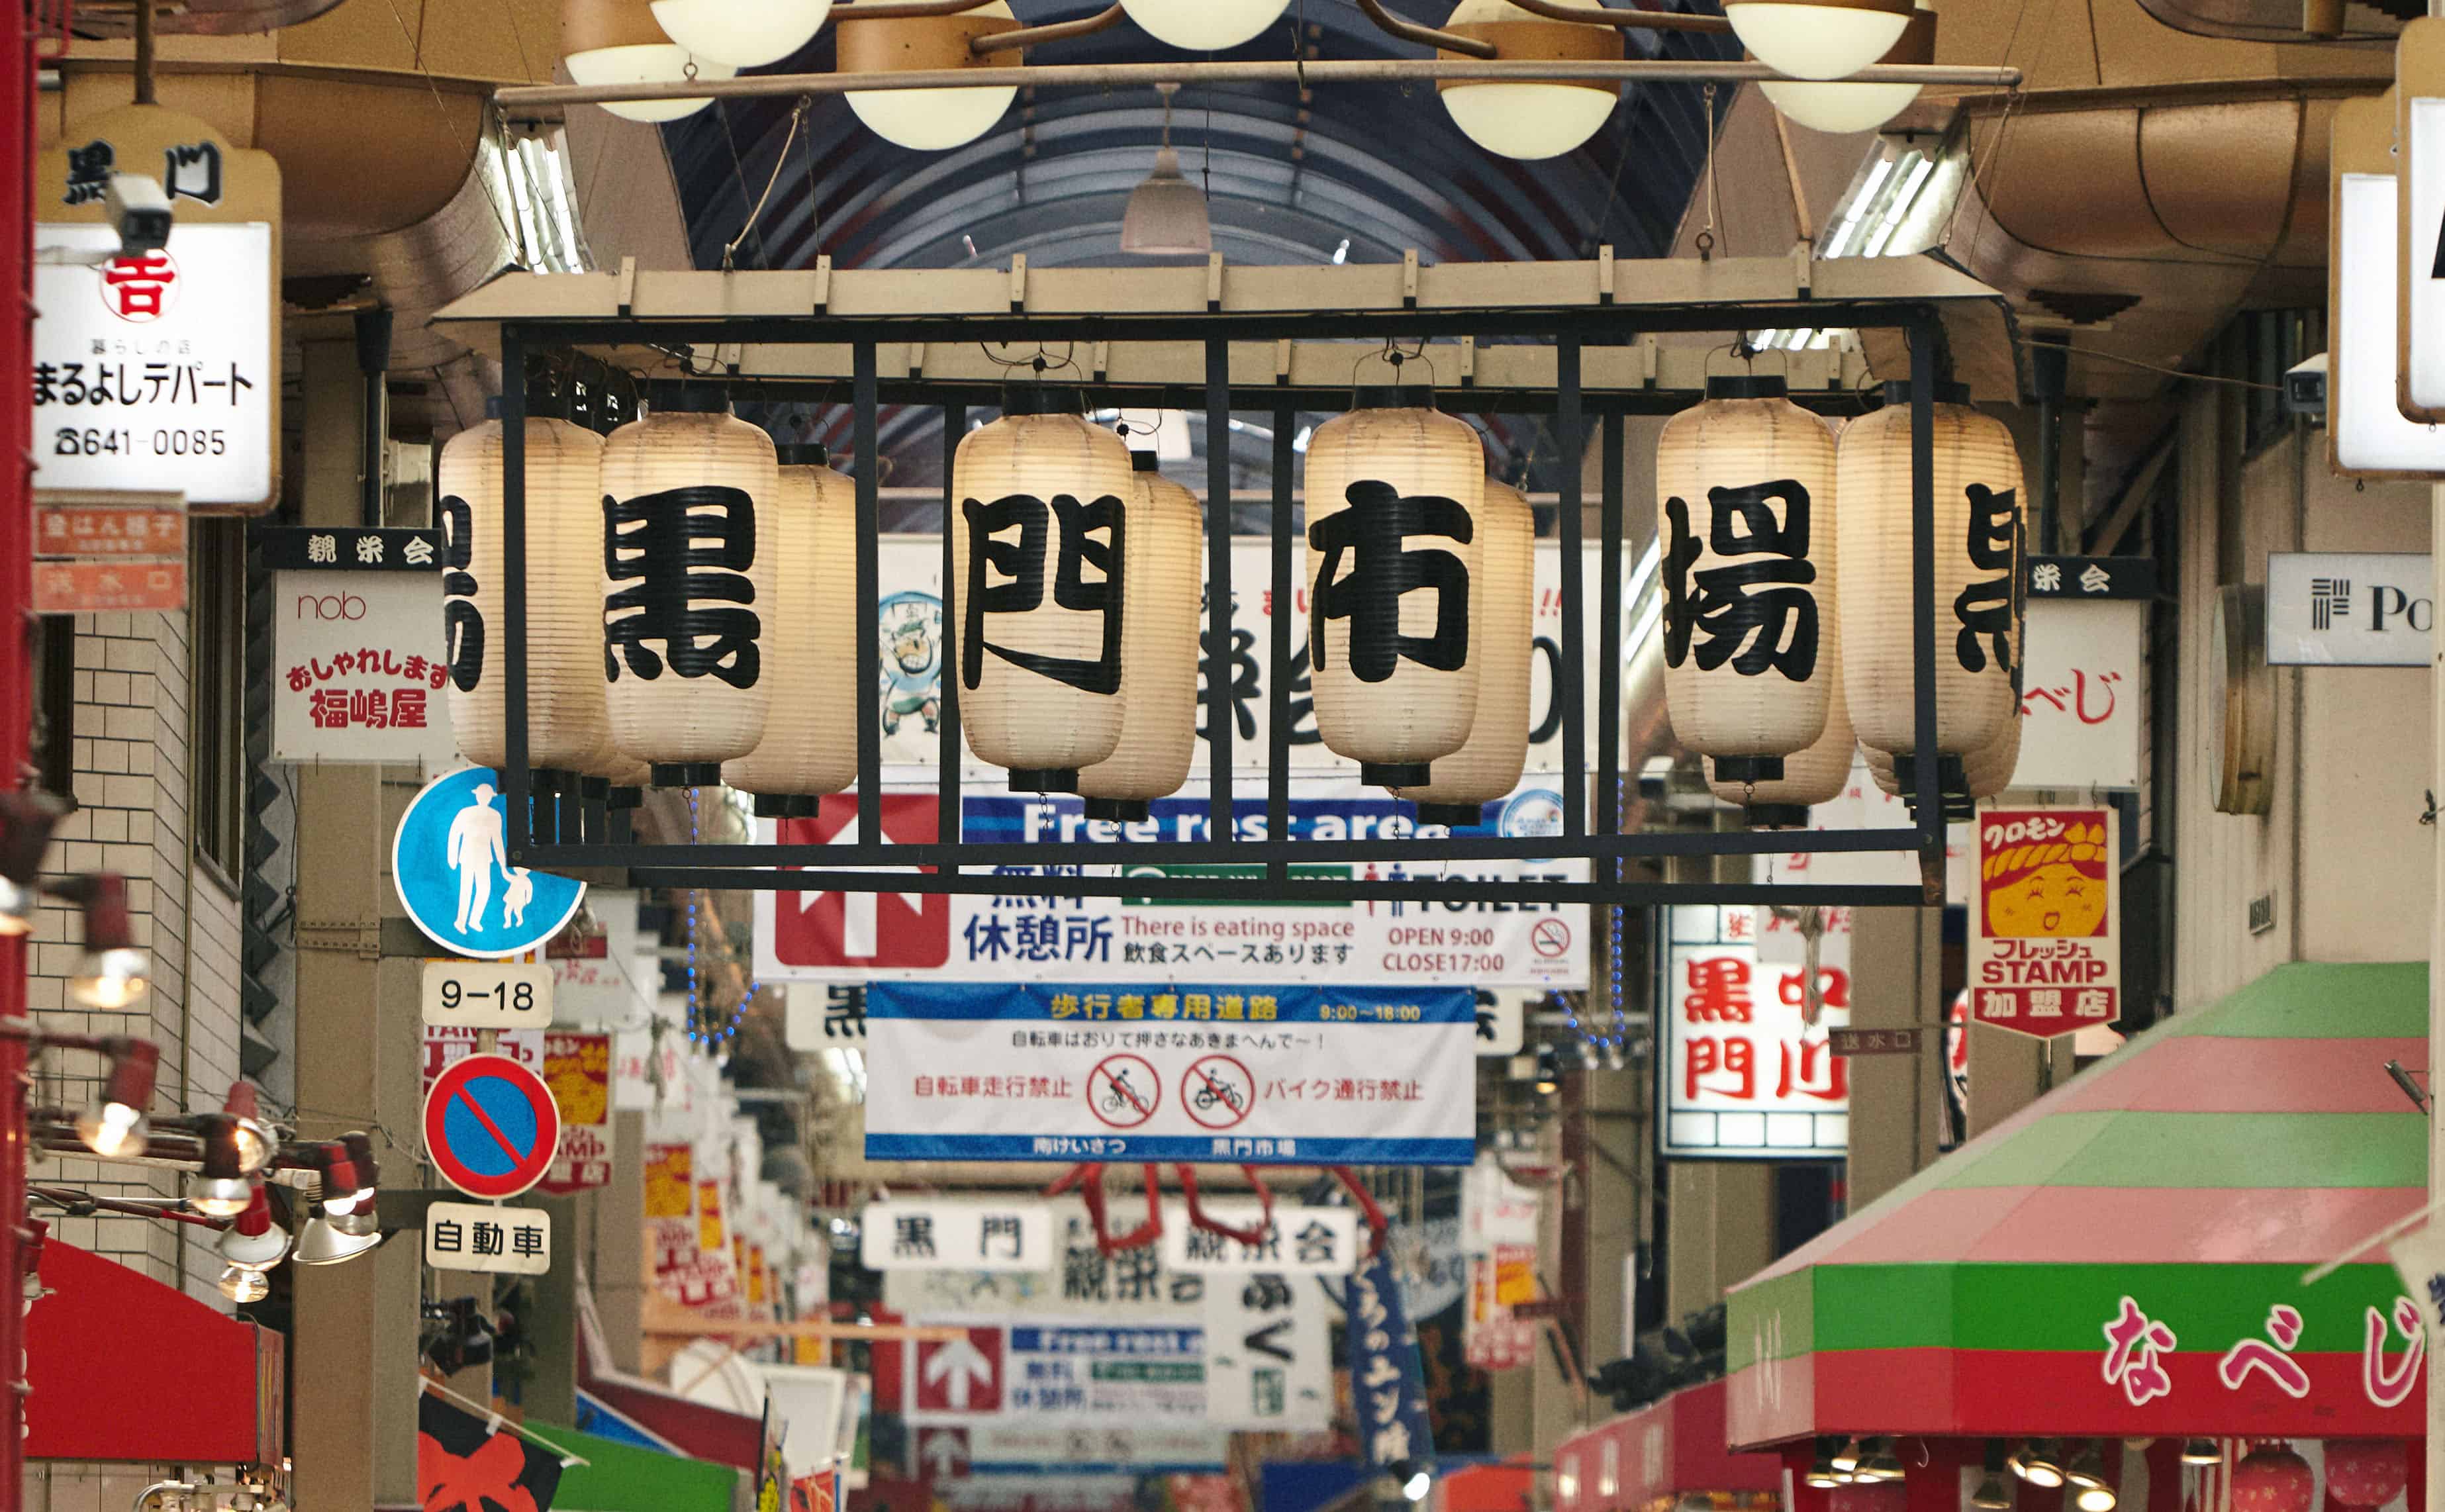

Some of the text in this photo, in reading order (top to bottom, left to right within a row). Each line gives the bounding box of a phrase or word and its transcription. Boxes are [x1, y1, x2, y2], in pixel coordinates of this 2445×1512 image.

[33, 361, 253, 406] まるよしデパート
[308, 534, 434, 564] 親栄会
[602, 485, 761, 690] 黒
[962, 493, 1126, 694] 門
[1309, 481, 1473, 682] 市
[1662, 479, 1819, 682] 場
[299, 591, 366, 620] nob
[286, 647, 450, 692] おしゃれします
[309, 688, 428, 729] 福嶋屋
[2023, 667, 2123, 725] べじ
[1024, 804, 1160, 843] Free
[1982, 815, 2066, 851] クロモン
[1413, 874, 1567, 912] TOILET
[963, 914, 1113, 962] 休憩所
[1122, 916, 1355, 941] There is eating space
[1388, 928, 1494, 946] OPEN 9:00
[1124, 942, 1353, 965] 飲食スペースあります
[1992, 939, 2093, 960] フレッシュ
[1982, 960, 2109, 984] STAMP
[441, 979, 534, 1012] 9-18
[1050, 994, 1278, 1020] 歩行者専用道路
[1982, 988, 2110, 1019] 加盟店
[914, 1074, 1073, 1098] 自転車走行禁止
[1264, 1077, 1425, 1102] バイク通行禁止
[1211, 1139, 1297, 1157] 黒門市場
[434, 1219, 545, 1258] 自動車
[893, 1216, 1023, 1258] 黒門
[2102, 1296, 2426, 1407] なべじ
